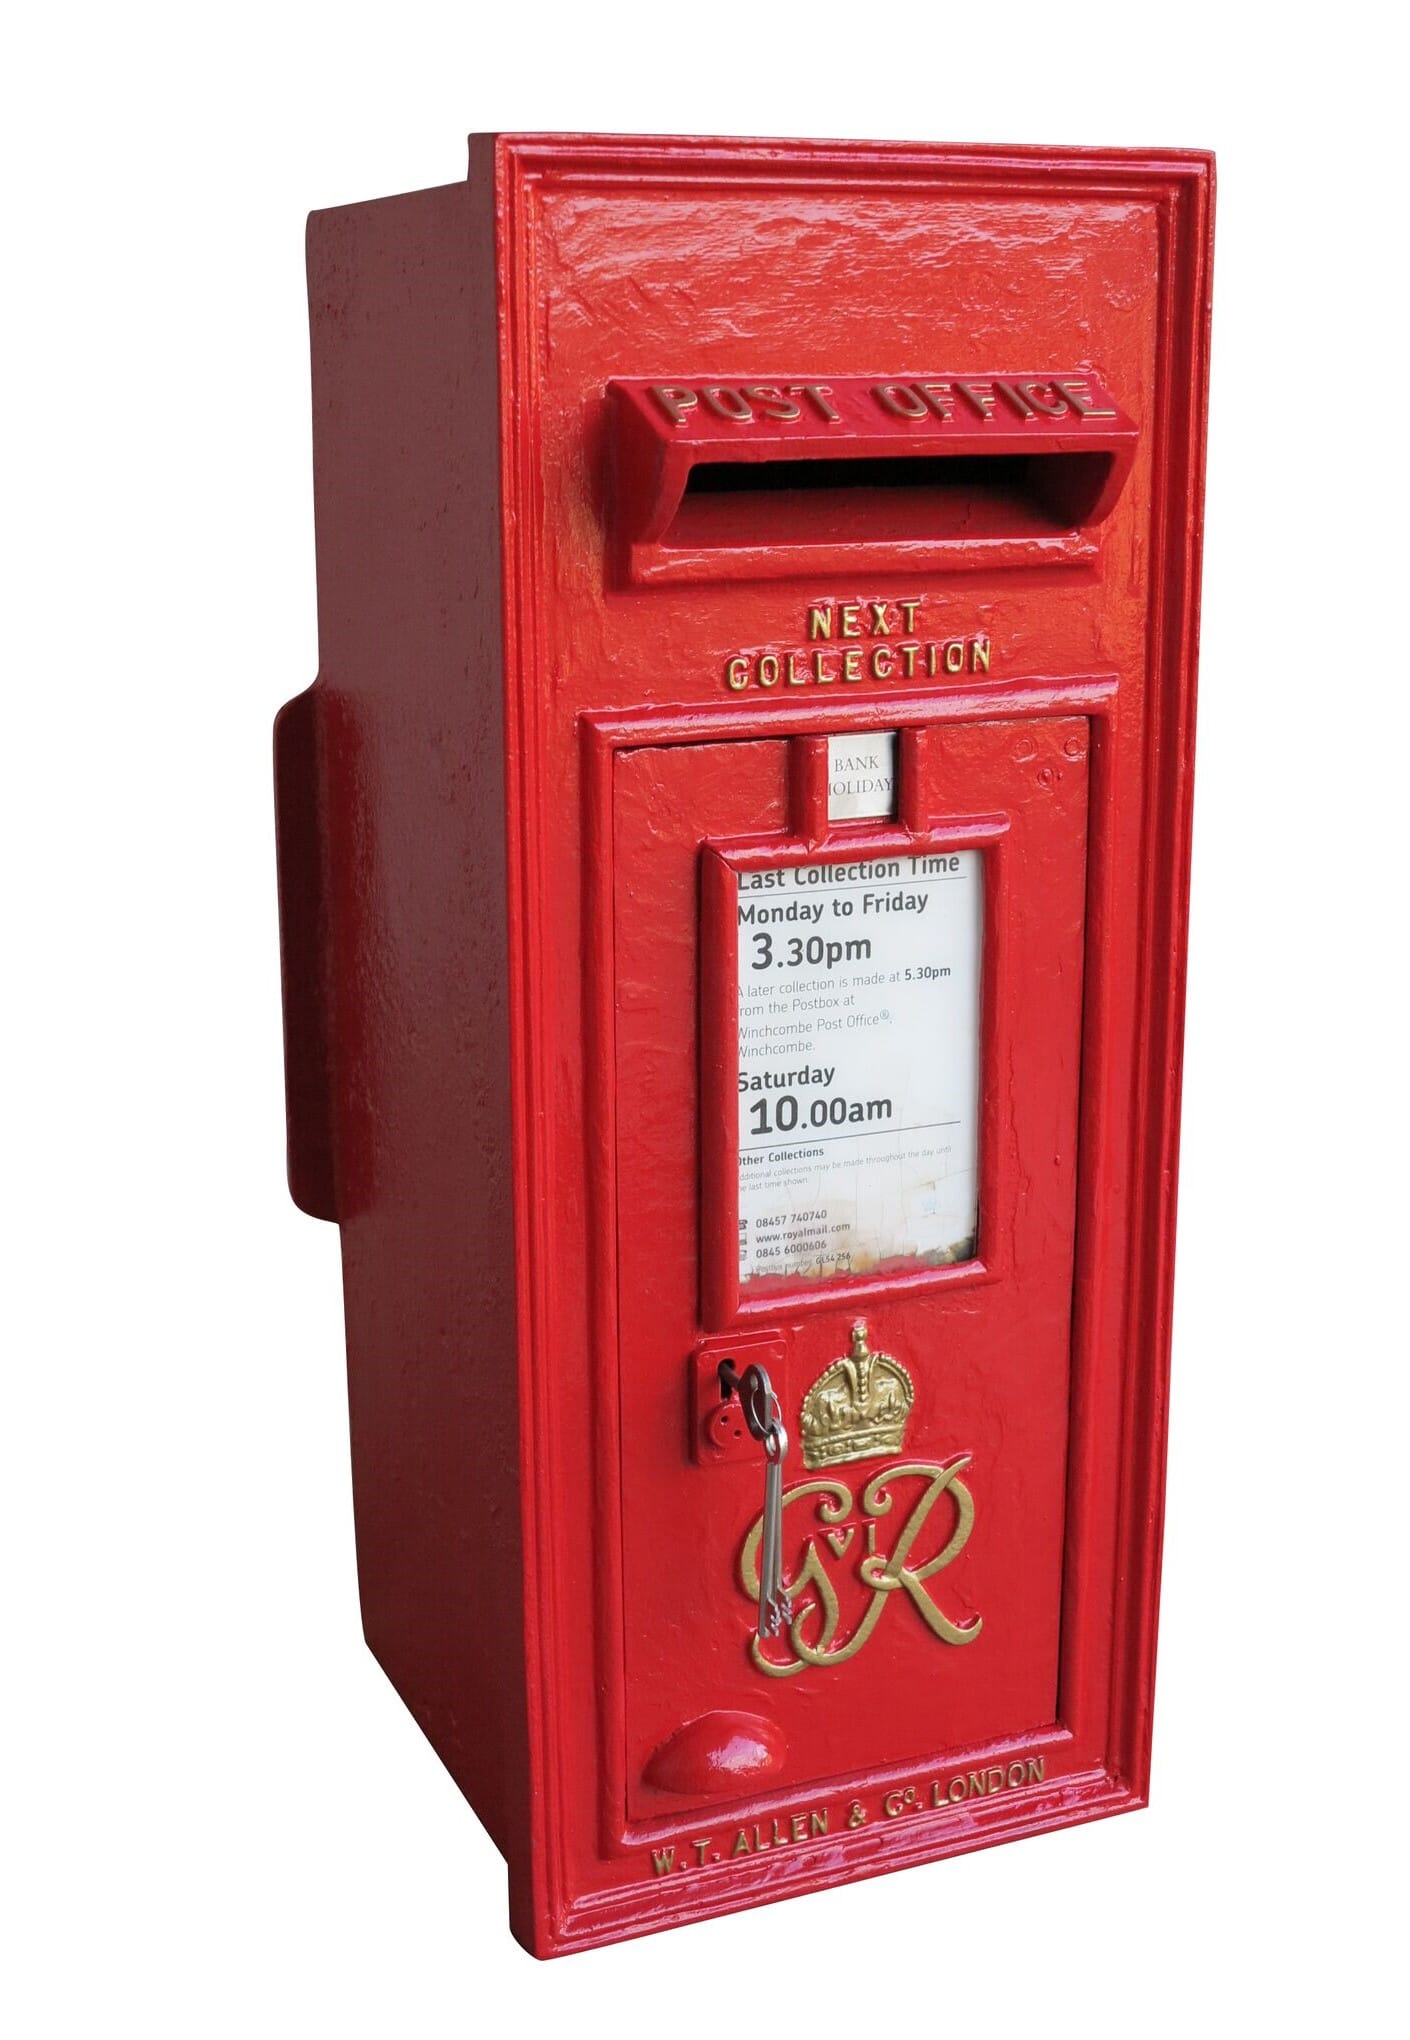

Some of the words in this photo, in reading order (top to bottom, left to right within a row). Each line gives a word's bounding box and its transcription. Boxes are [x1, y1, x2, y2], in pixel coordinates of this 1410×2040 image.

[651, 383, 840, 428] POST
[878, 381, 1117, 422] OFFICE
[809, 600, 921, 640] NEXT
[726, 638, 991, 690] COLLECTION
[835, 756, 879, 773] BANK
[738, 869, 786, 891] Last
[794, 862, 899, 886] Collection
[908, 855, 960, 876] Time
[738, 900, 824, 926] Monday
[832, 900, 854, 916] to
[863, 891, 929, 914] Friday
[751, 932, 872, 971] 3.30pm
[747, 985, 774, 997] later
[779, 977, 835, 995] collection
[839, 976, 849, 988] is
[852, 973, 885, 986] made
[889, 971, 901, 983] at
[904, 966, 951, 982] 5.30pm
[739, 1006, 764, 1017] rom
[768, 1000, 788, 1014] the
[792, 995, 839, 1012] Postbox
[843, 995, 855, 1006] at
[817, 1015, 842, 1031] Post
[738, 1065, 836, 1093] Saturday
[750, 1094, 893, 1136] 10.00am
[768, 1147, 825, 1163] Collections
[773, 1165, 813, 1178] collections
[866, 1151, 906, 1165] throughout
[755, 1215, 787, 1230] 08457
[790, 1209, 828, 1225] 740740
[755, 1223, 851, 1245] www.royalmail.com
[755, 1246, 781, 1259] 0845
[783, 1239, 827, 1256] 6000606
[731, 1807, 830, 1856] ALLEN
[847, 1800, 866, 1828] &
[932, 1756, 1046, 1807] LONDON
